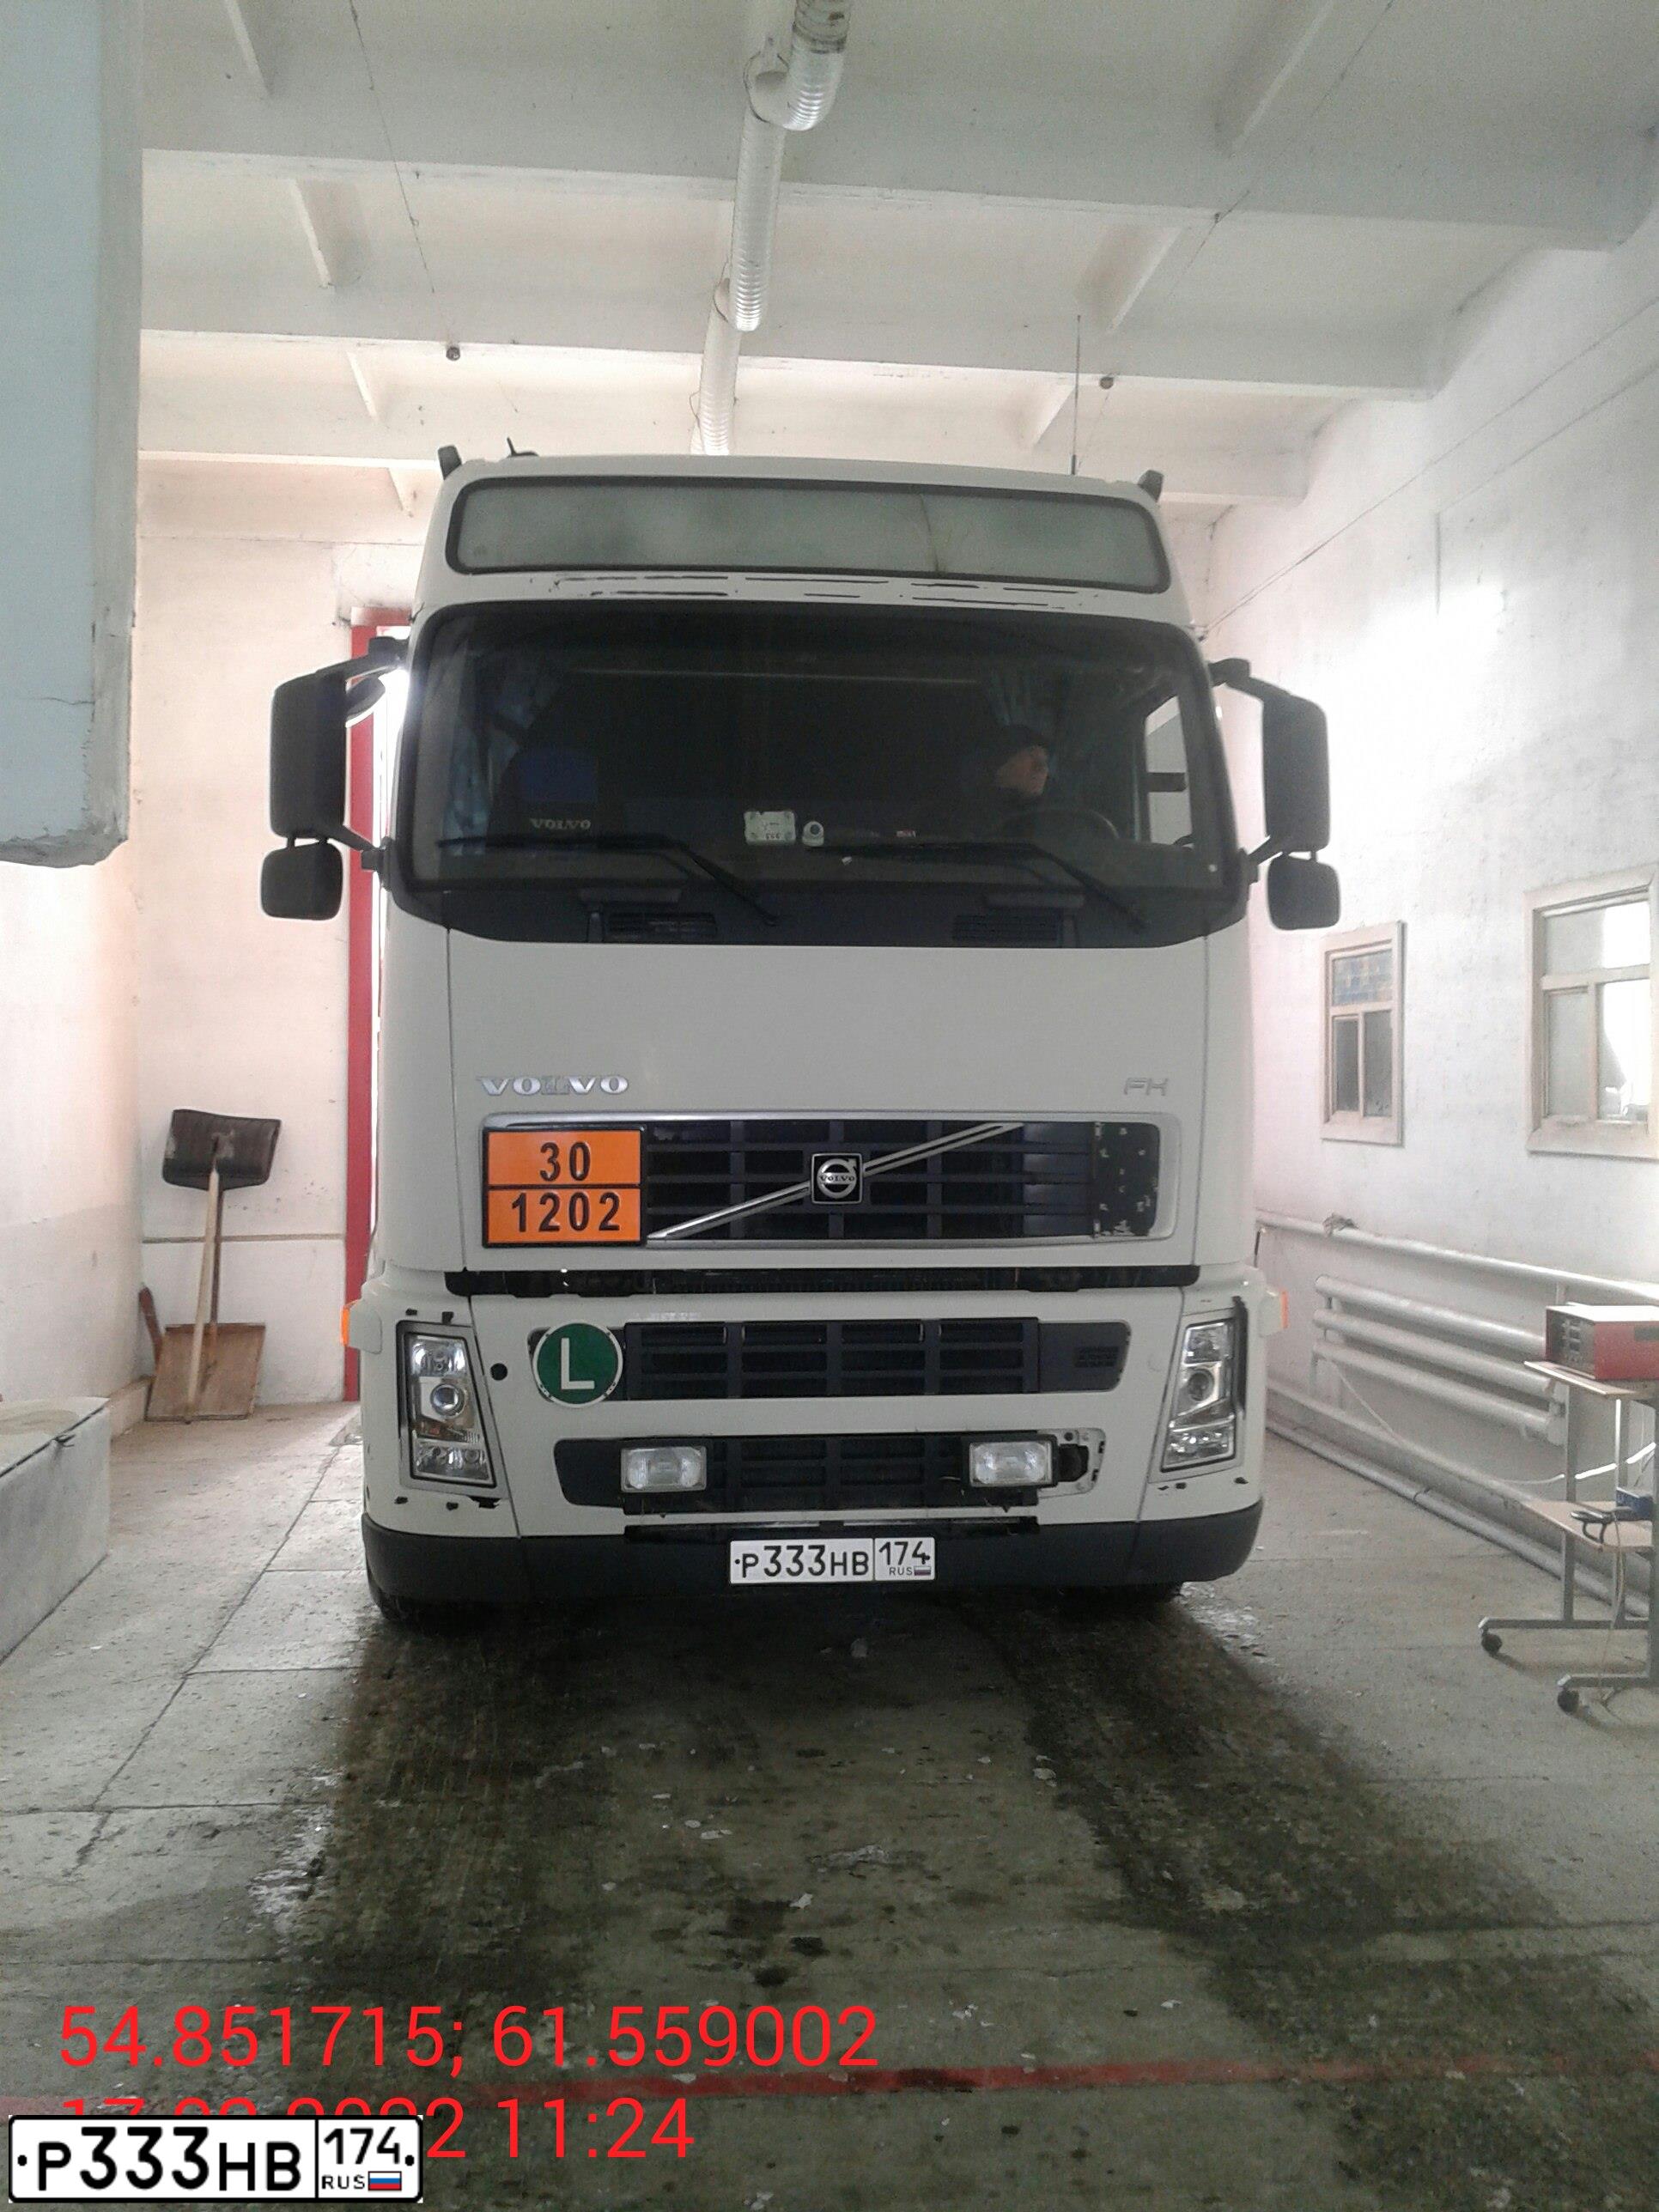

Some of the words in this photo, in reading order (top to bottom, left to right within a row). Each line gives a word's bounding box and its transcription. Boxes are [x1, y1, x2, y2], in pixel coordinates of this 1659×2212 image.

[529, 817, 592, 831] VOLVO
[477, 1074, 629, 1097] VOLVO
[1123, 1077, 1169, 1097] FH
[539, 1141, 591, 1182] 30
[511, 1191, 620, 1233] 1202
[560, 1337, 595, 1390] L
[878, 1540, 927, 1565] 174
[889, 1566, 913, 1576] RUS
